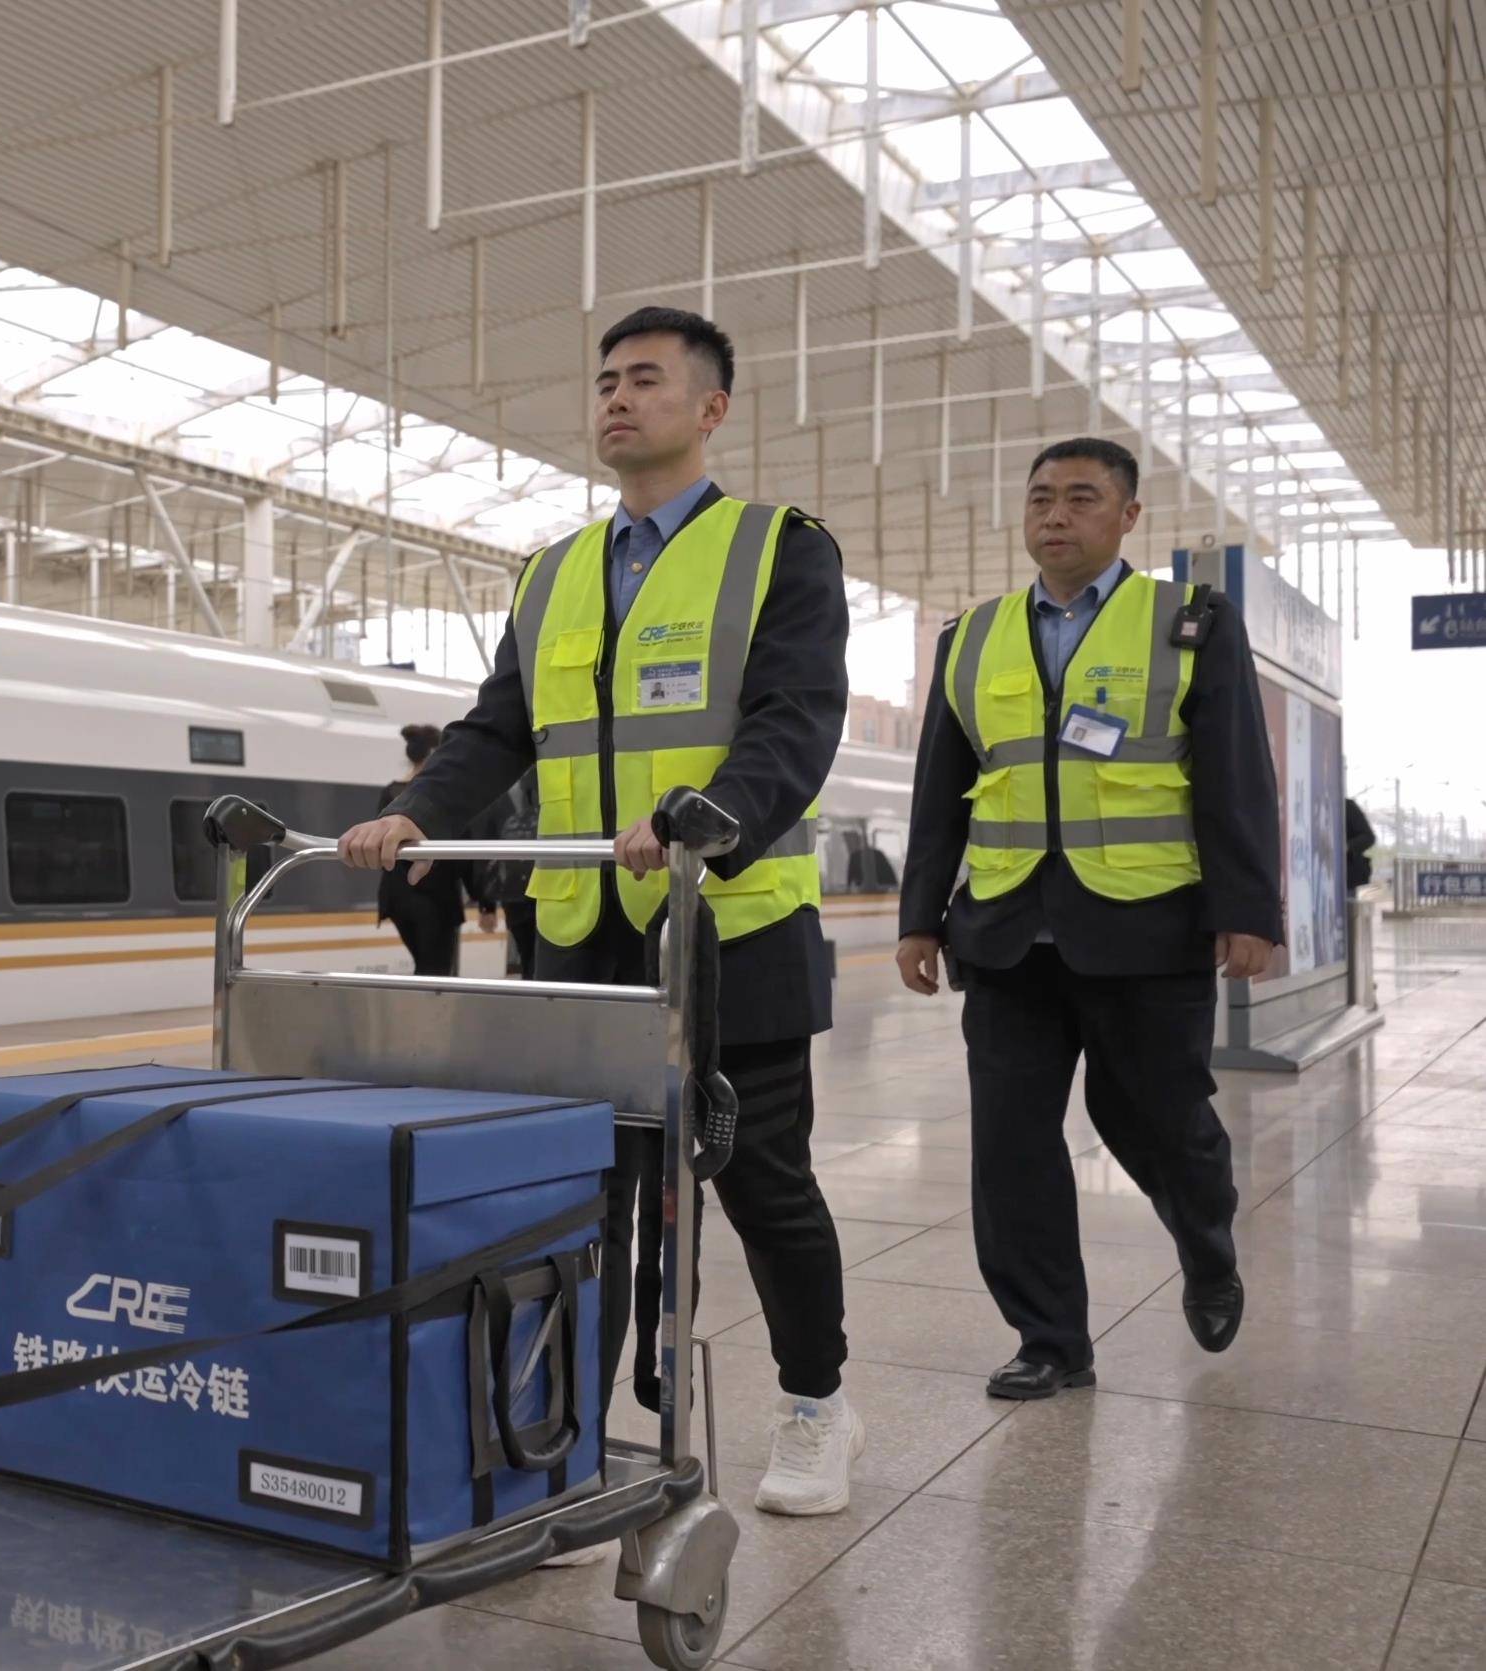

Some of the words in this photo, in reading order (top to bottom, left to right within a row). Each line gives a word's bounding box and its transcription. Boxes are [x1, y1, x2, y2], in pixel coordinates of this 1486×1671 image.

[1423, 874, 1486, 896] 行包通
[66, 1273, 191, 1334] CRE
[260, 1472, 347, 1506] S35480012
